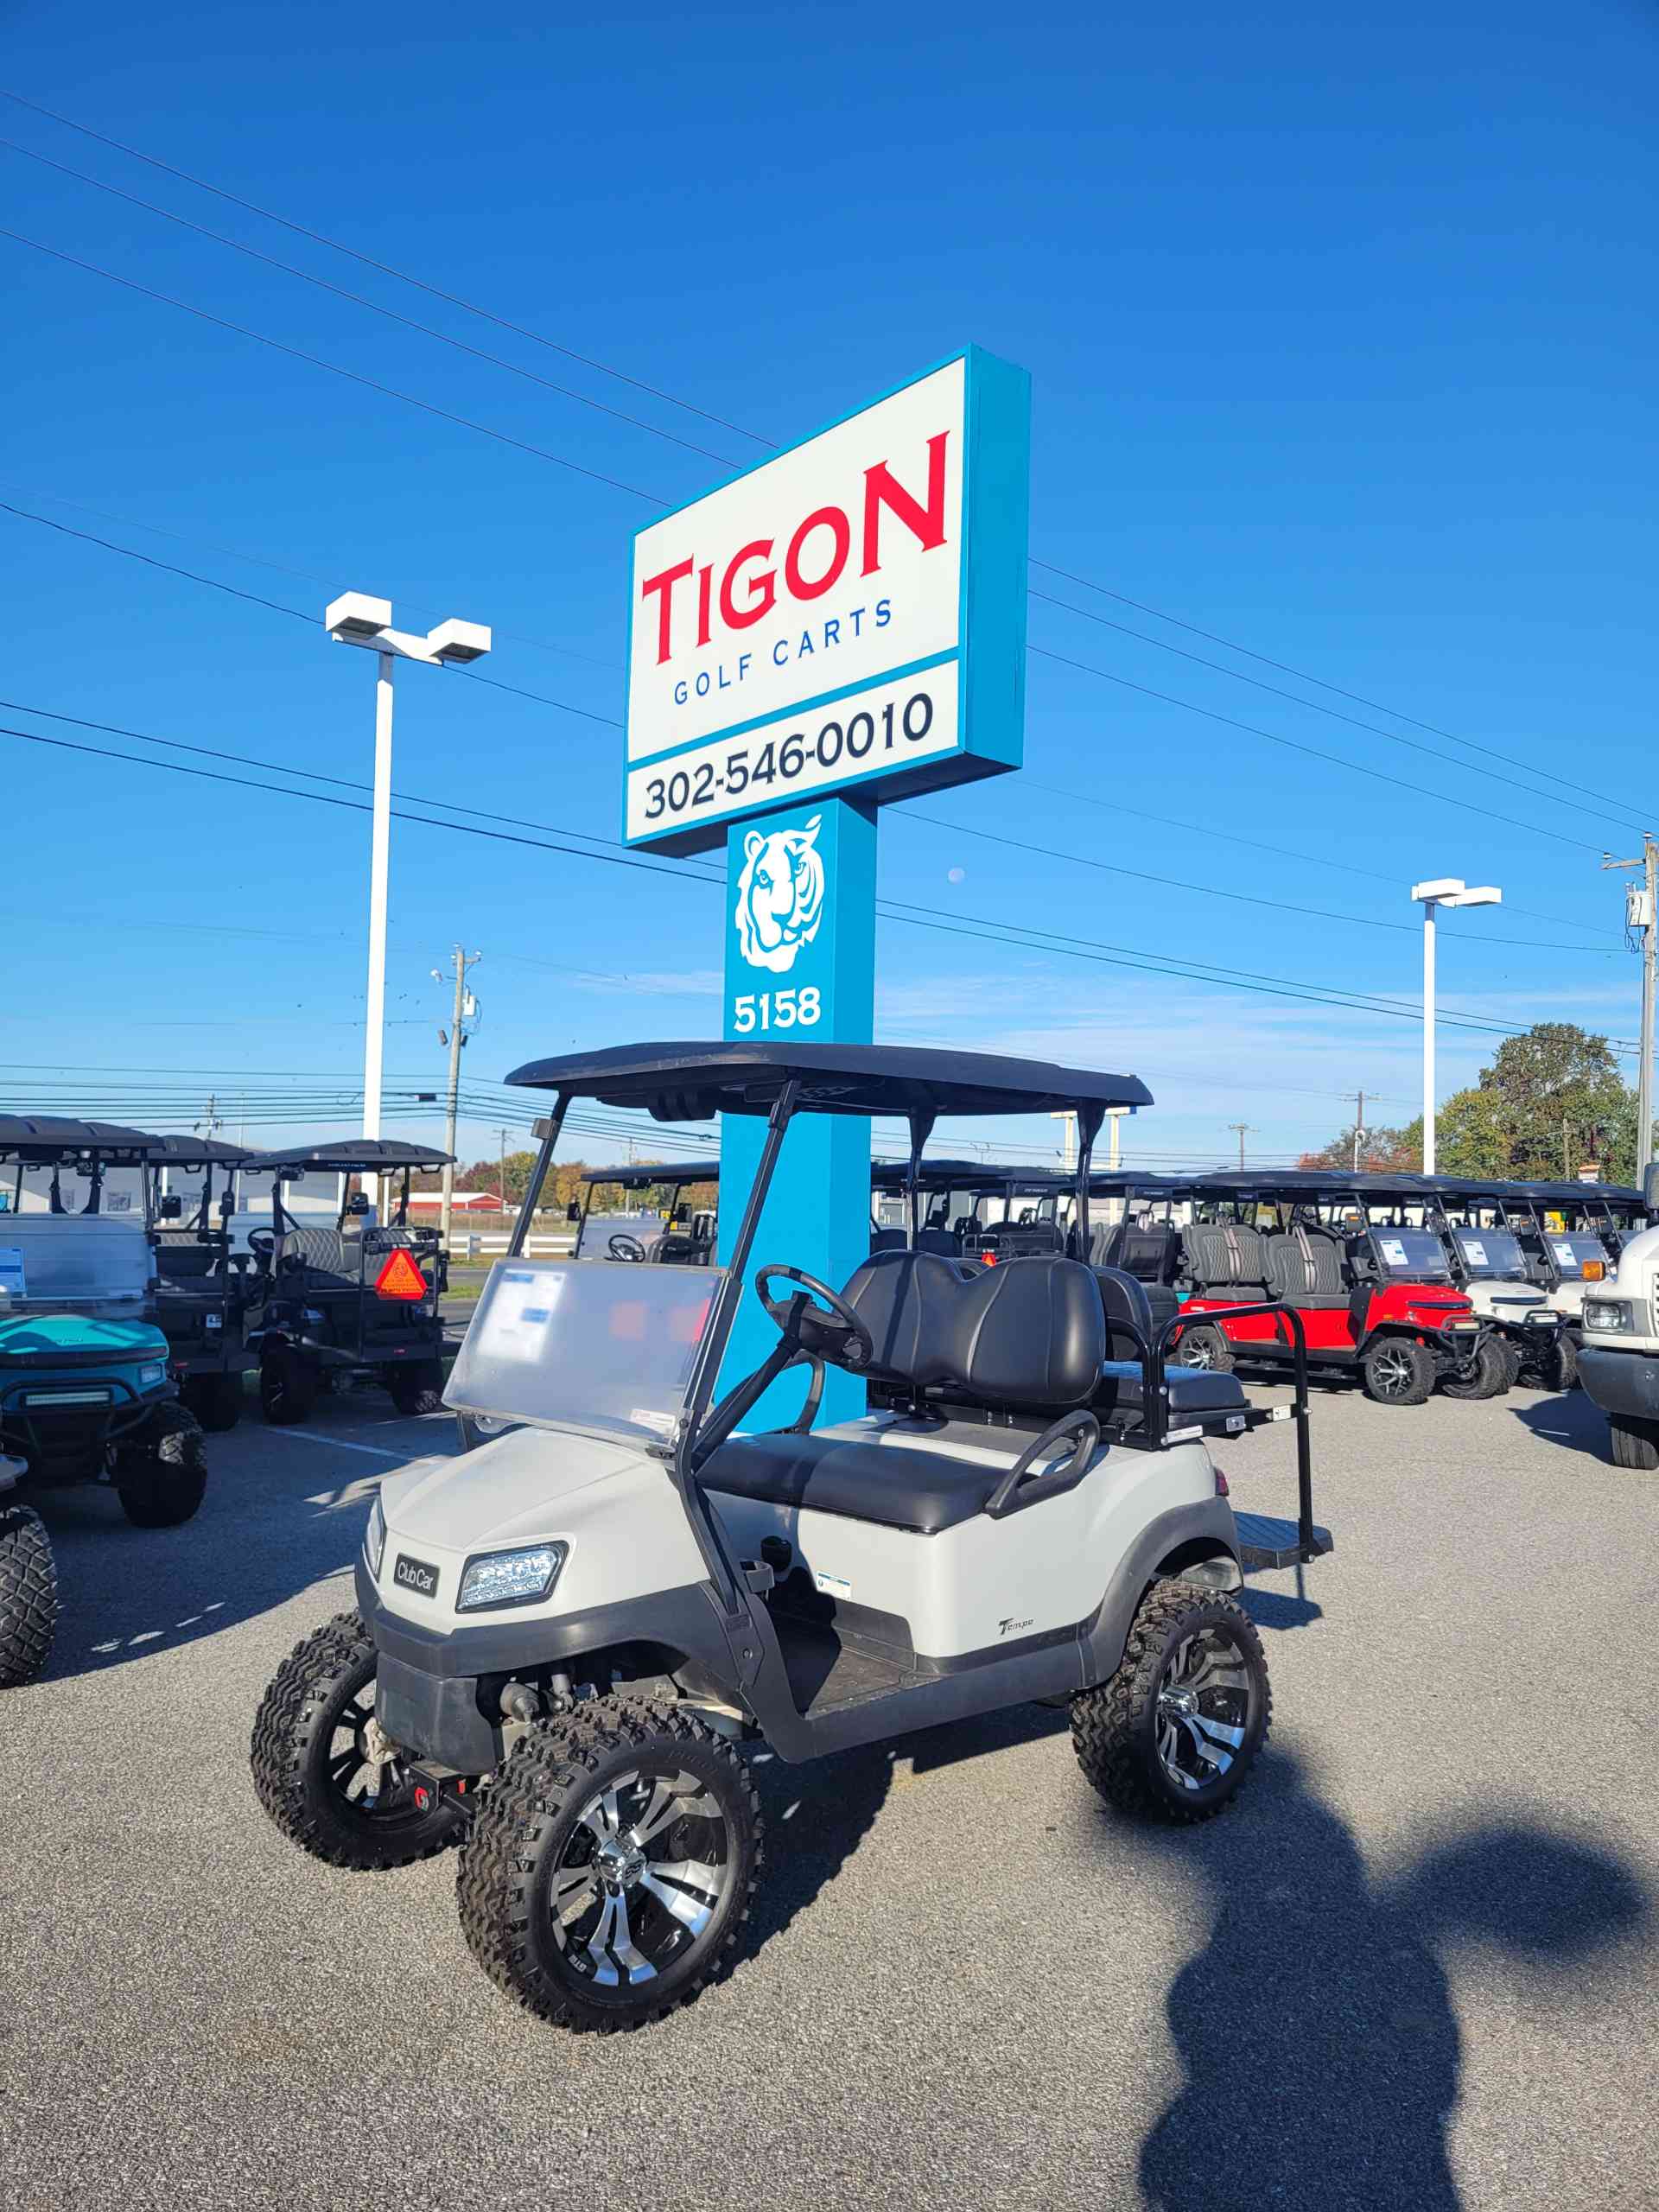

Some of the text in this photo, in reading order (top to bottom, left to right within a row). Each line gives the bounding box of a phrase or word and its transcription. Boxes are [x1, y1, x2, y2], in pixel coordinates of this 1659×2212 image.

[642, 431, 950, 664] TIGON
[673, 599, 892, 706] GOLF CARTS
[644, 692, 934, 819] 302-546-0010
[734, 987, 821, 1033] 5158
[398, 1561, 434, 1591] Club Car
[998, 1618, 1034, 1635] Tempo
